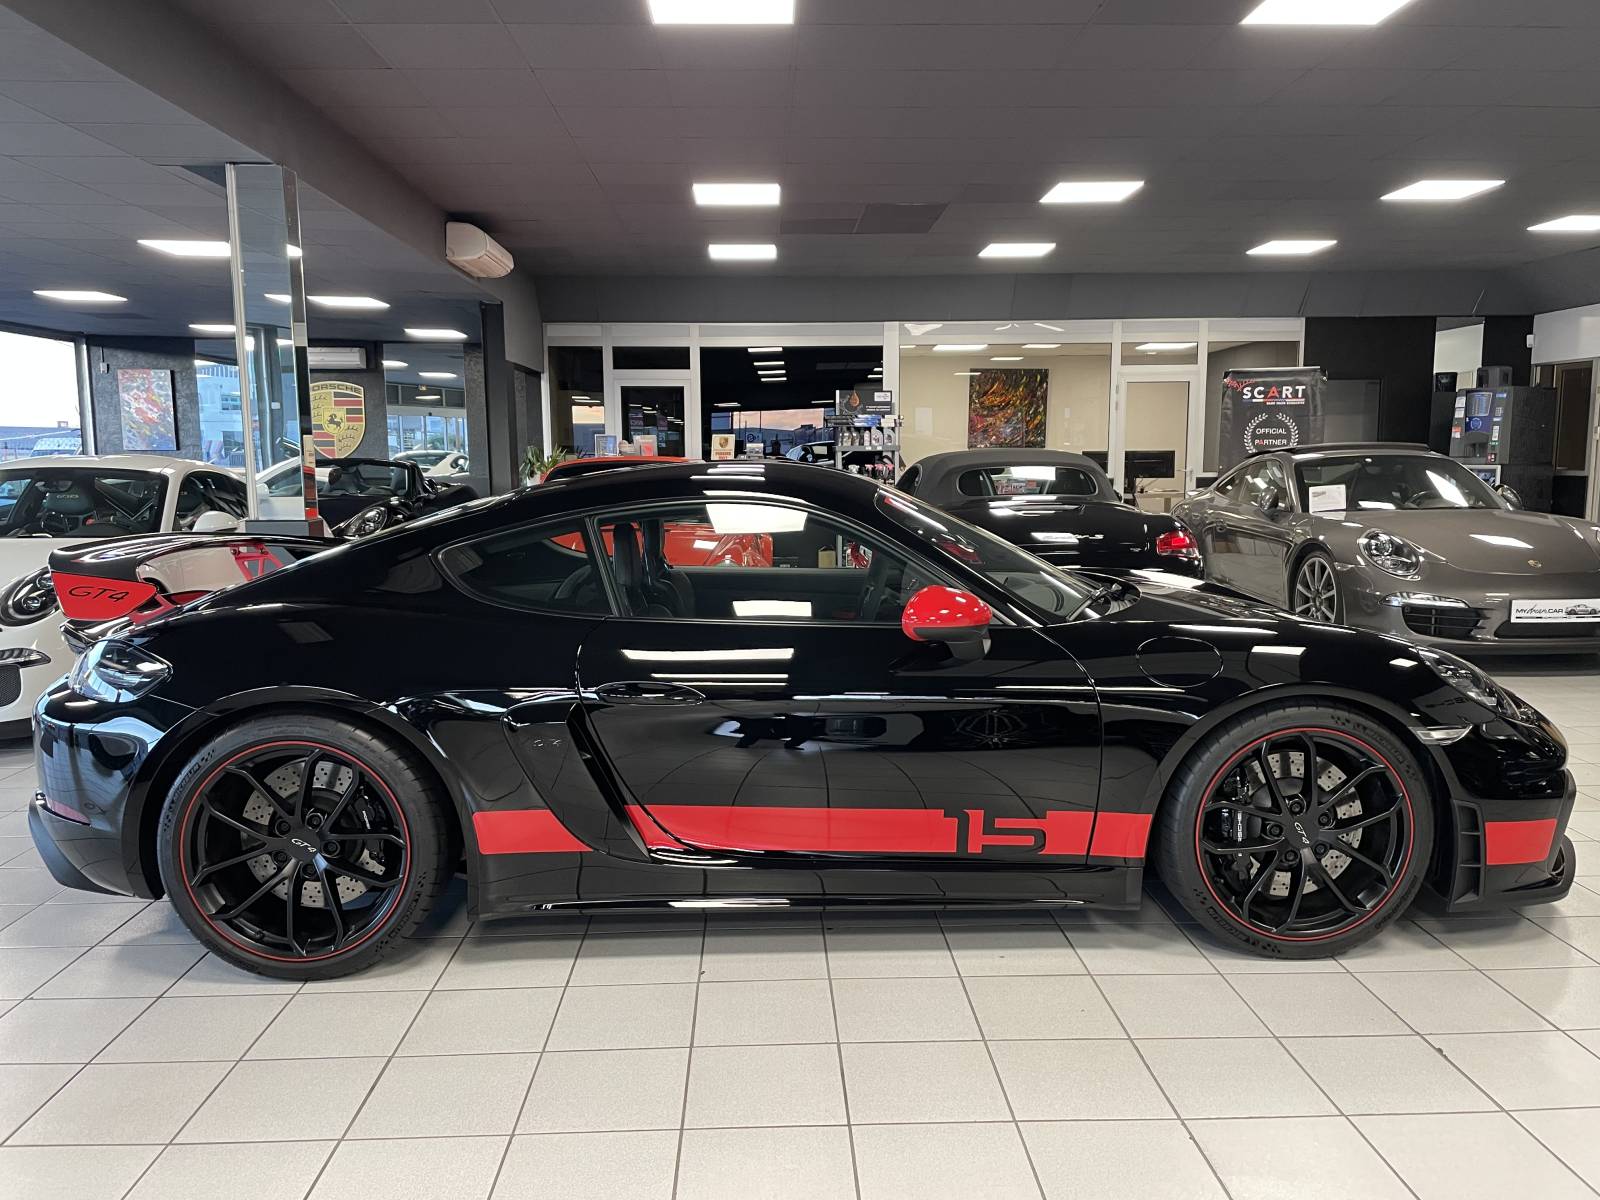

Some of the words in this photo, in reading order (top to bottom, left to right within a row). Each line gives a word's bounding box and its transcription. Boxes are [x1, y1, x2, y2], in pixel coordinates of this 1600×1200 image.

[312, 383, 362, 395] ORSCHE
[1242, 385, 1306, 399] SCART
[68, 586, 130, 603] GT4
[943, 809, 1047, 854] 15
[1294, 821, 1310, 844] GT4
[291, 838, 317, 853] GT4
